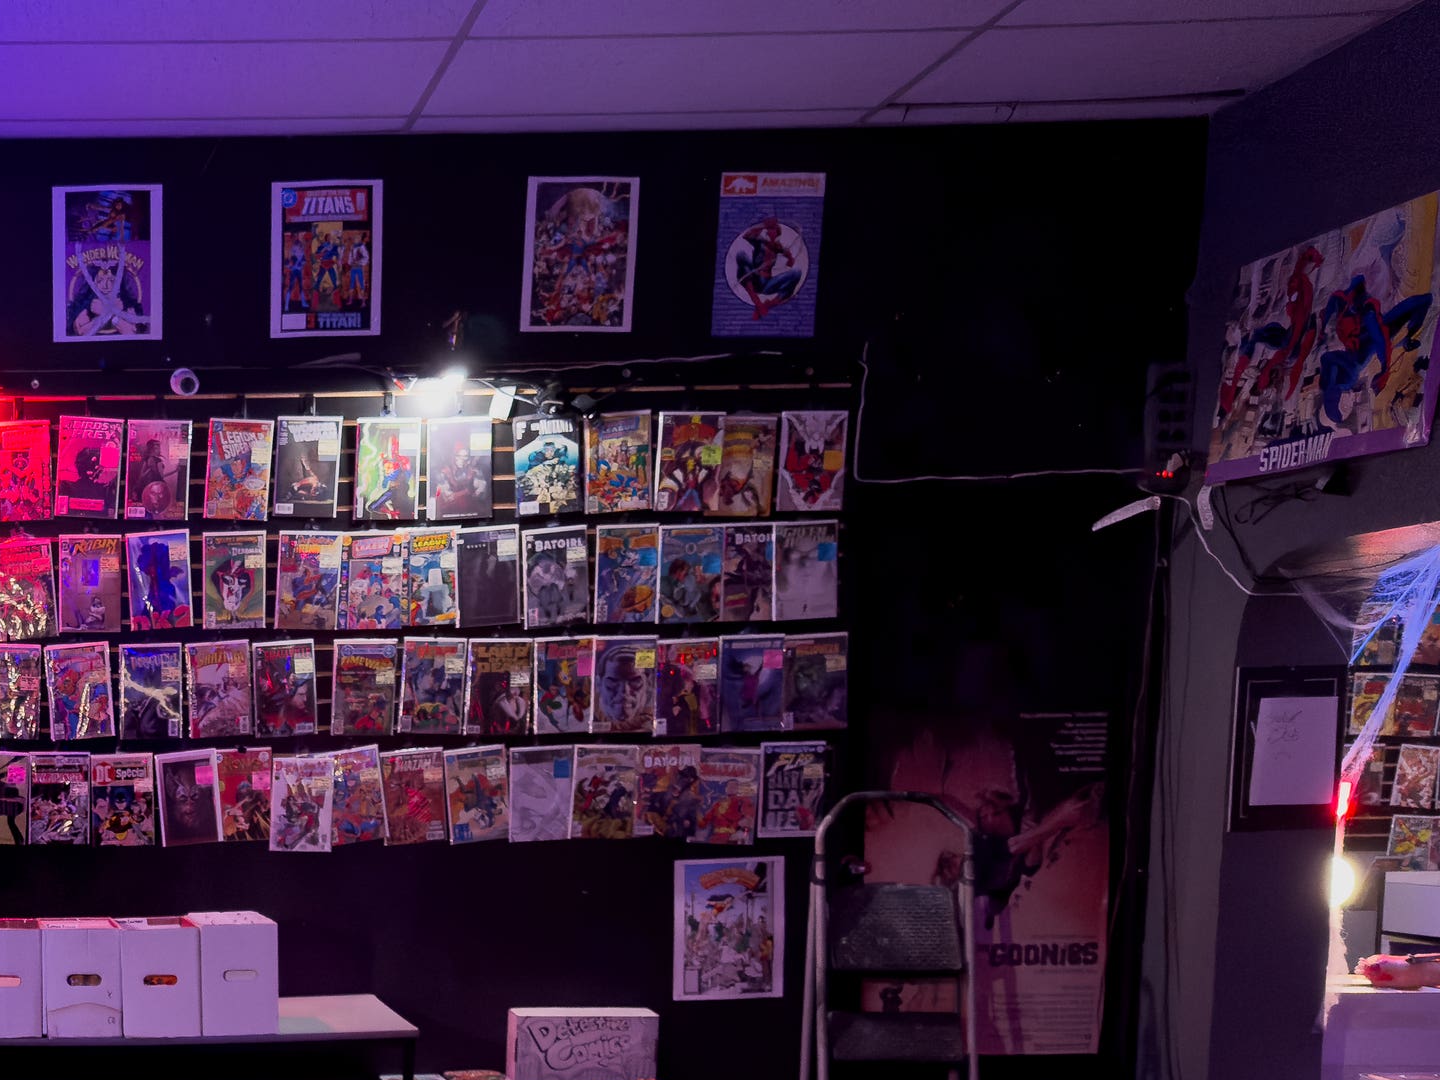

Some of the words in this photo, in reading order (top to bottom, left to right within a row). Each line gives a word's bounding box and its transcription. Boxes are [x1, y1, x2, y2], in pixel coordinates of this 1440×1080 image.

[302, 196, 355, 215] TITANS
[66, 247, 106, 269] WNDER
[72, 420, 109, 431] BIRDS
[71, 430, 113, 440] PREY
[534, 537, 583, 552] BATGIRL
